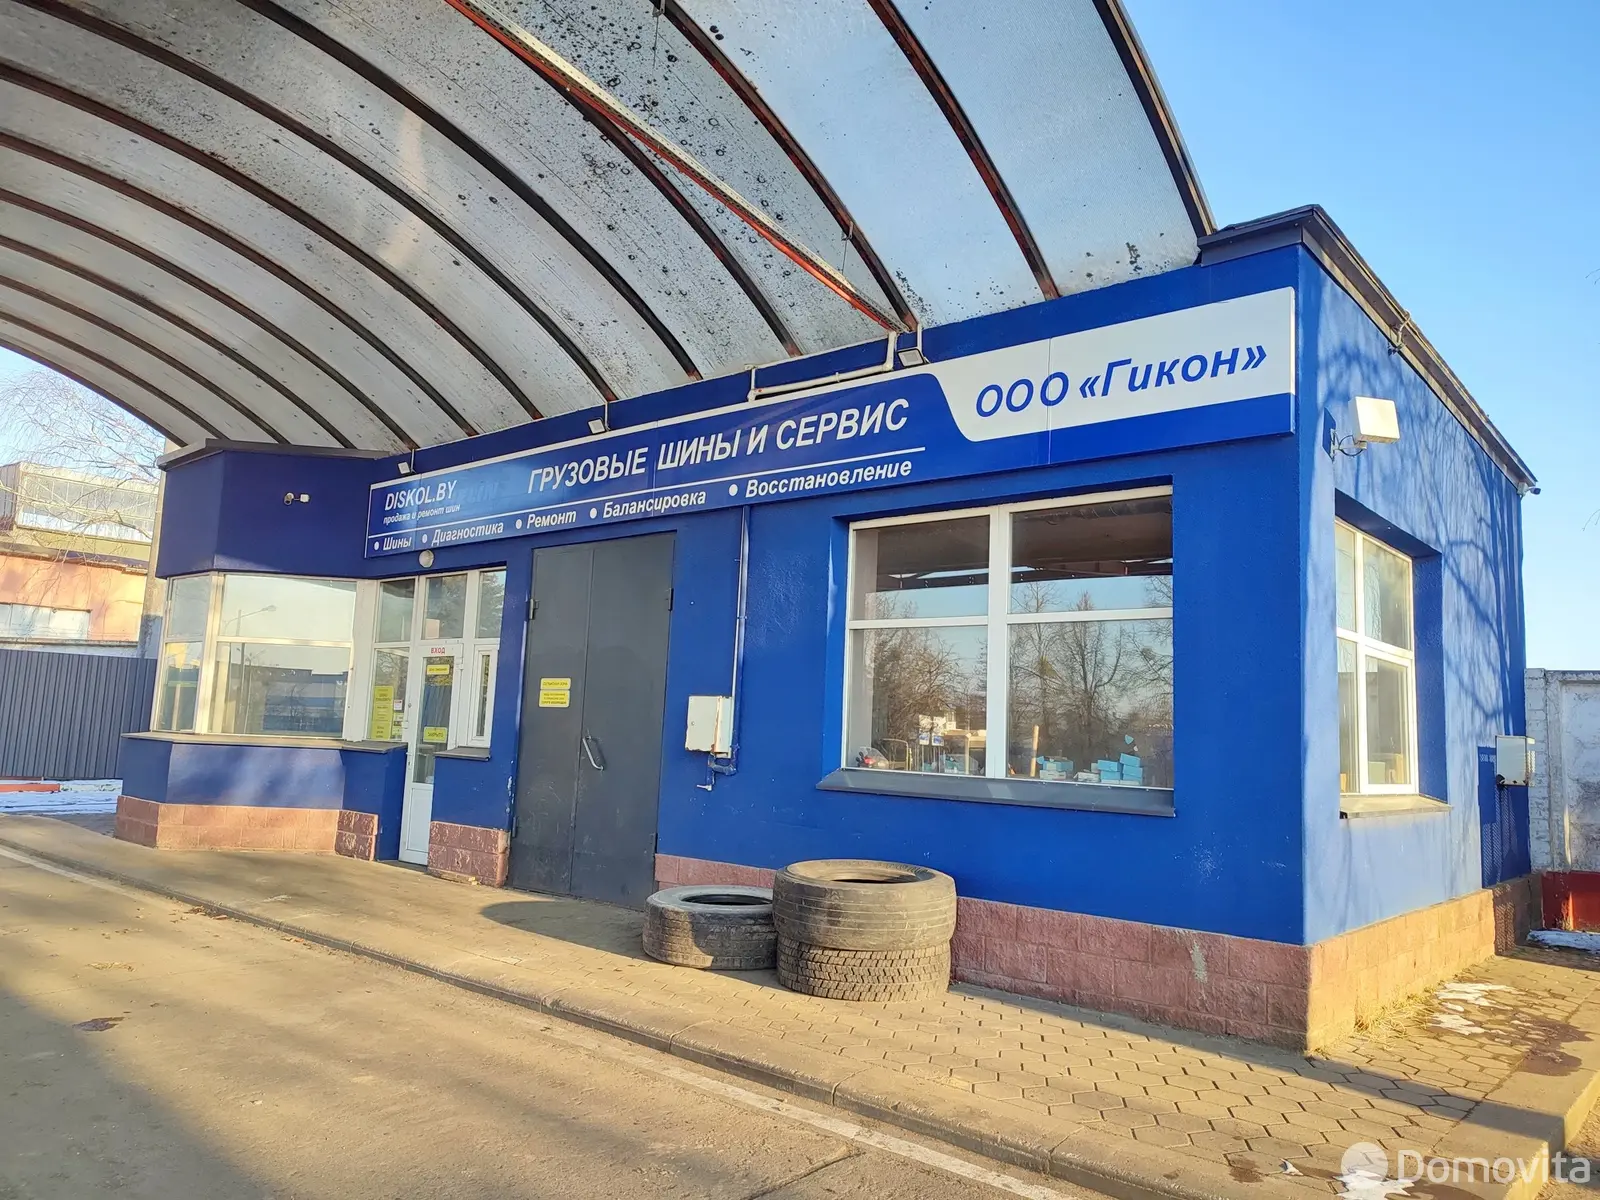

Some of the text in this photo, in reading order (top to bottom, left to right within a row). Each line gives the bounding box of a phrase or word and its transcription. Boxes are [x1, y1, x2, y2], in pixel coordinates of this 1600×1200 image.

[975, 345, 1267, 418] ООО «Гикон»
[527, 447, 649, 494] ГРУЗОВЫЕ
[656, 431, 740, 472] ШИНЫ
[745, 424, 768, 456] И
[775, 398, 910, 451] СЕРВИС
[382, 459, 912, 551] Шины Диагностика Ремонт Балансировка Восстановление
[383, 503, 461, 526] продажа и ремонт шин
[384, 479, 458, 511] DISKOL.BY
[430, 647, 446, 655] ВХОД
